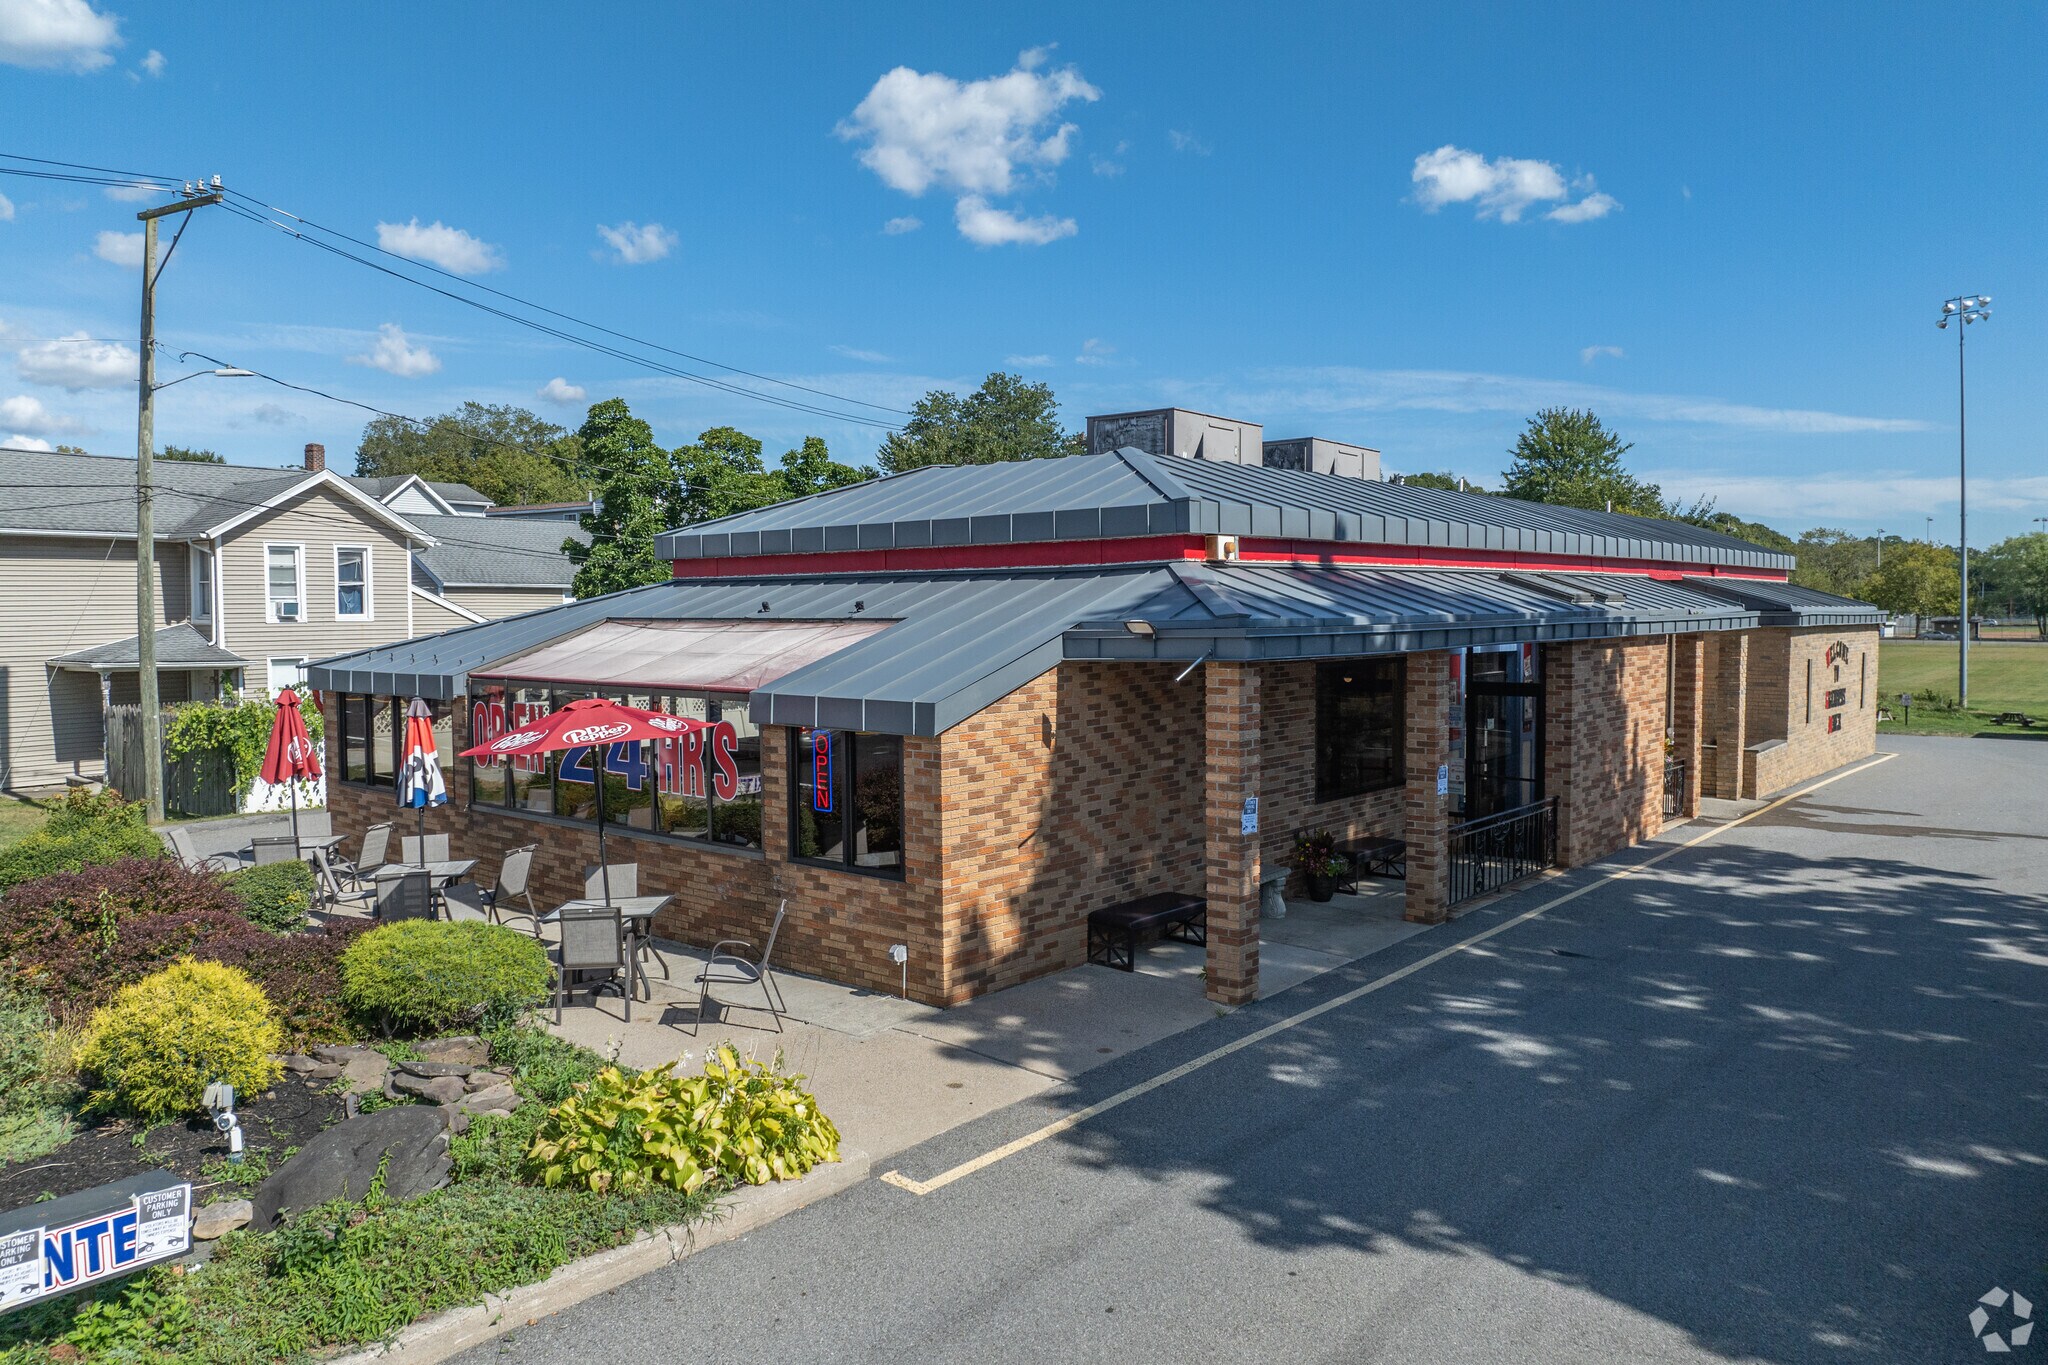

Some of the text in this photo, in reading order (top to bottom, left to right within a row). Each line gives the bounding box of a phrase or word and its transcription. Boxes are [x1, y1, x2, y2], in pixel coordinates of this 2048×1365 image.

[565, 725, 627, 744] Pepper
[585, 725, 610, 736] Dr
[473, 701, 546, 774] OPEN
[657, 717, 739, 801] HRS
[815, 735, 829, 808] OPEN
[143, 1189, 182, 1205] CUSTOMER
[146, 1199, 179, 1213] PARKING
[152, 1208, 172, 1219] ONLY
[0, 1234, 35, 1250] STOMER
[1, 1254, 24, 1267] ONLY
